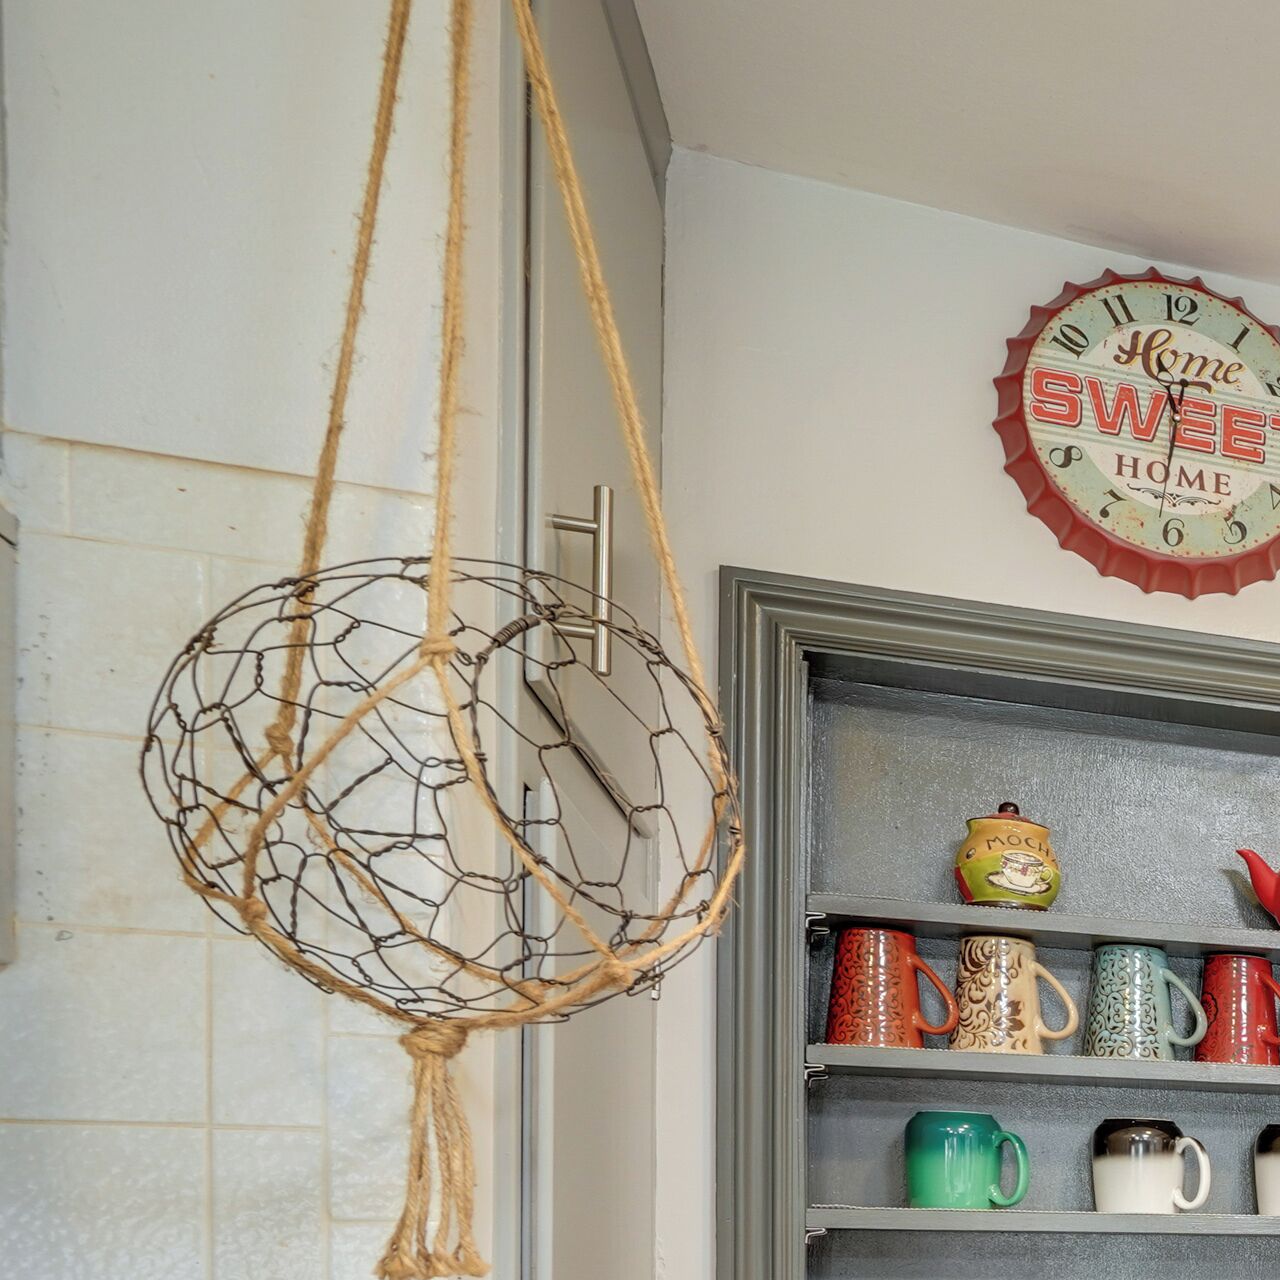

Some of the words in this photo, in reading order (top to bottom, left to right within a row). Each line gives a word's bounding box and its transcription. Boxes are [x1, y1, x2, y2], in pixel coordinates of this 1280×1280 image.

[1099, 294, 1138, 327] 11
[1162, 293, 1200, 327] 12
[1050, 323, 1090, 360] 10
[1226, 323, 1251, 354] 1
[1113, 328, 1244, 393] Home
[1049, 445, 1083, 469] 8
[1115, 453, 1232, 496] HOME
[1099, 489, 1127, 519] 7
[1162, 518, 1185, 547] 6
[1223, 515, 1248, 545] 5
[986, 834, 1056, 863] MOCH
